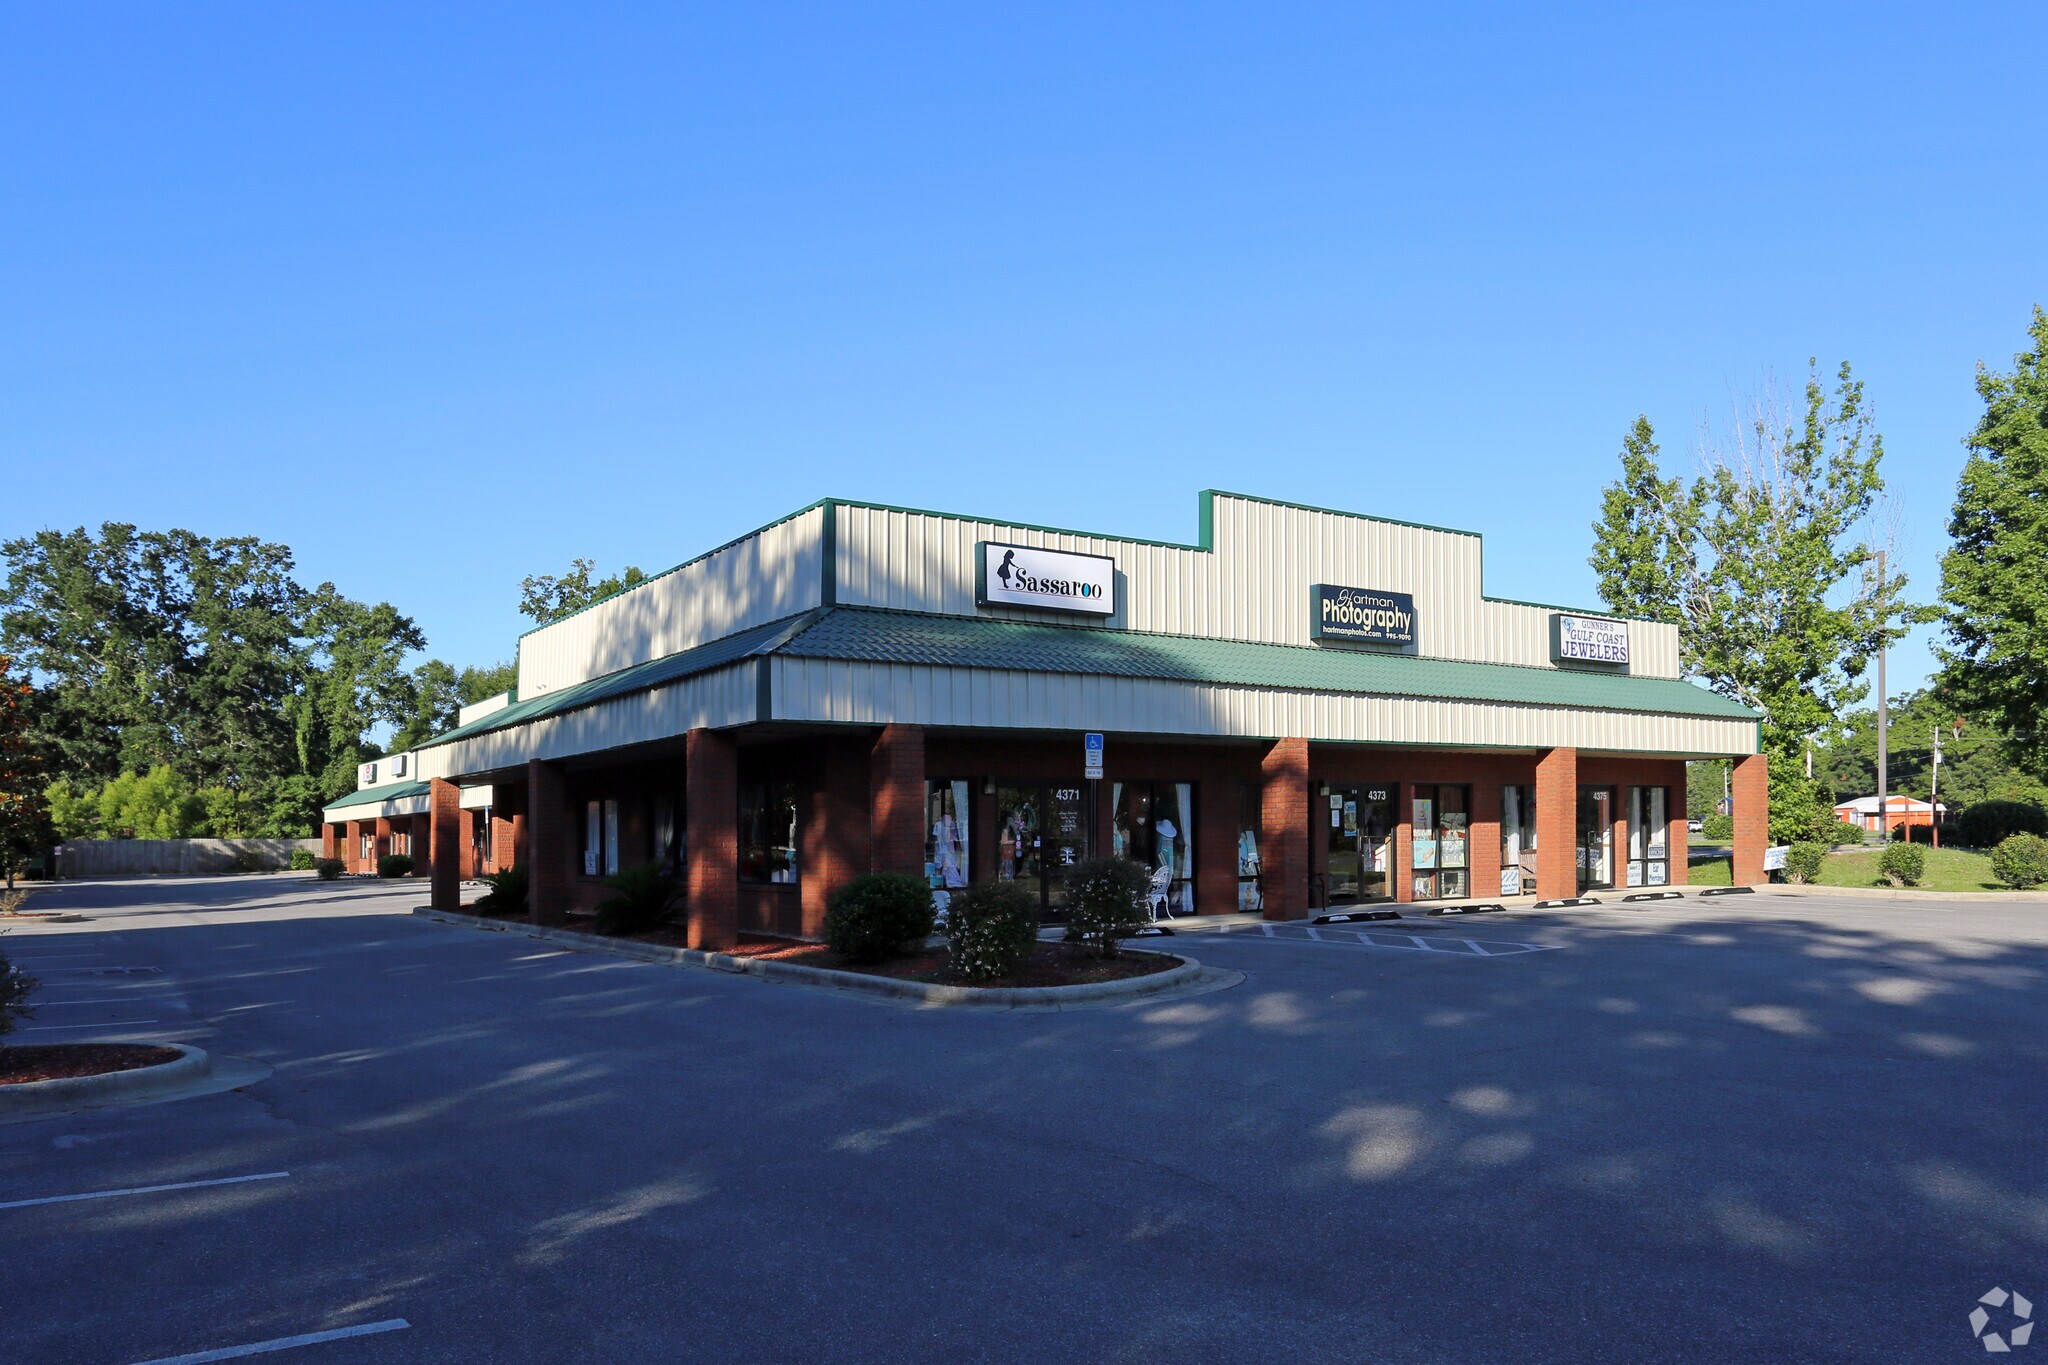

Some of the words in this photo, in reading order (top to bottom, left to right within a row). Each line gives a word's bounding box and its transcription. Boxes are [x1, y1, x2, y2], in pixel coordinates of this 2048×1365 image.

[1015, 567, 1102, 599] Sassaroo
[1336, 588, 1394, 608] Hartman
[1322, 598, 1411, 634] Photography
[1322, 625, 1382, 638] hartmanphotos.com
[1581, 620, 1615, 632] GUNNER'S
[1385, 632, 1412, 641] 995-9090
[1570, 629, 1594, 642] GULF
[1596, 632, 1625, 646] COAST
[1562, 641, 1627, 661] JEWELERS
[1056, 789, 1080, 800] 4371
[1368, 790, 1386, 801] 4373
[1593, 792, 1607, 800] 4375
